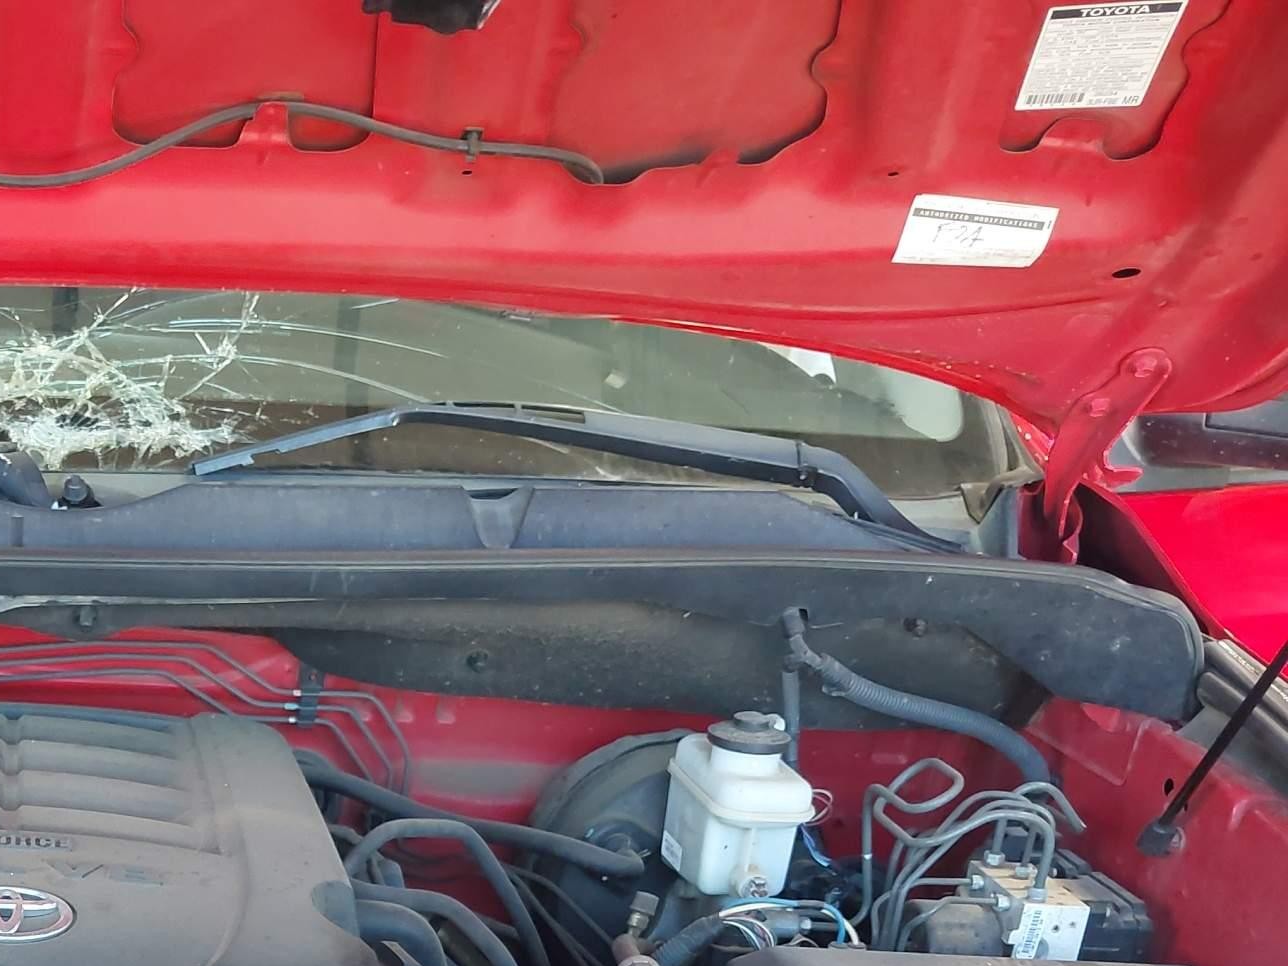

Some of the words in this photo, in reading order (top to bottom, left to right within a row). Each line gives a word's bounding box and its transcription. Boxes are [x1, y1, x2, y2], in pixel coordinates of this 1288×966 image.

[1080, 5, 1151, 17] TOYOTA
[1121, 95, 1140, 105] MR
[918, 209, 970, 222] AUTHORIZED
